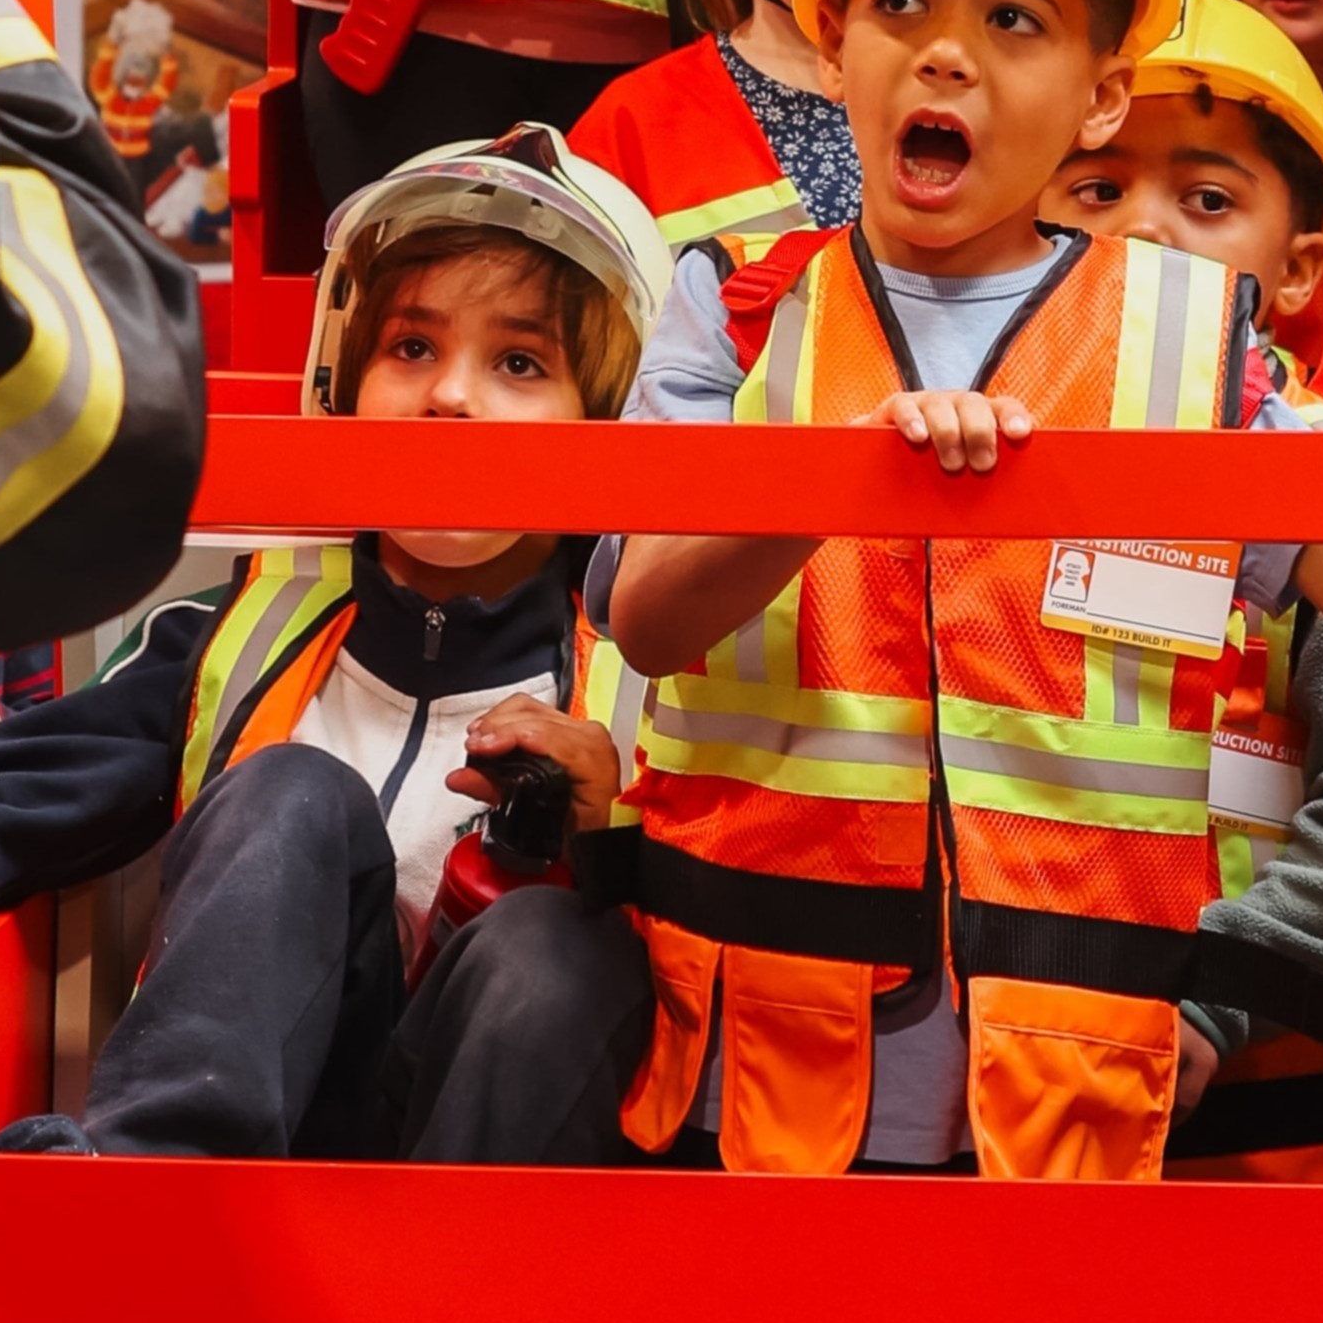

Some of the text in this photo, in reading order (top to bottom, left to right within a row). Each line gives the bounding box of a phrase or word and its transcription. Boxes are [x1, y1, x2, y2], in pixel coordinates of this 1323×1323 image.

[1196, 555, 1230, 574] SITE
[1051, 601, 1086, 613] FOREMAN
[1091, 625, 1172, 648] ID# 123 BUILD IT
